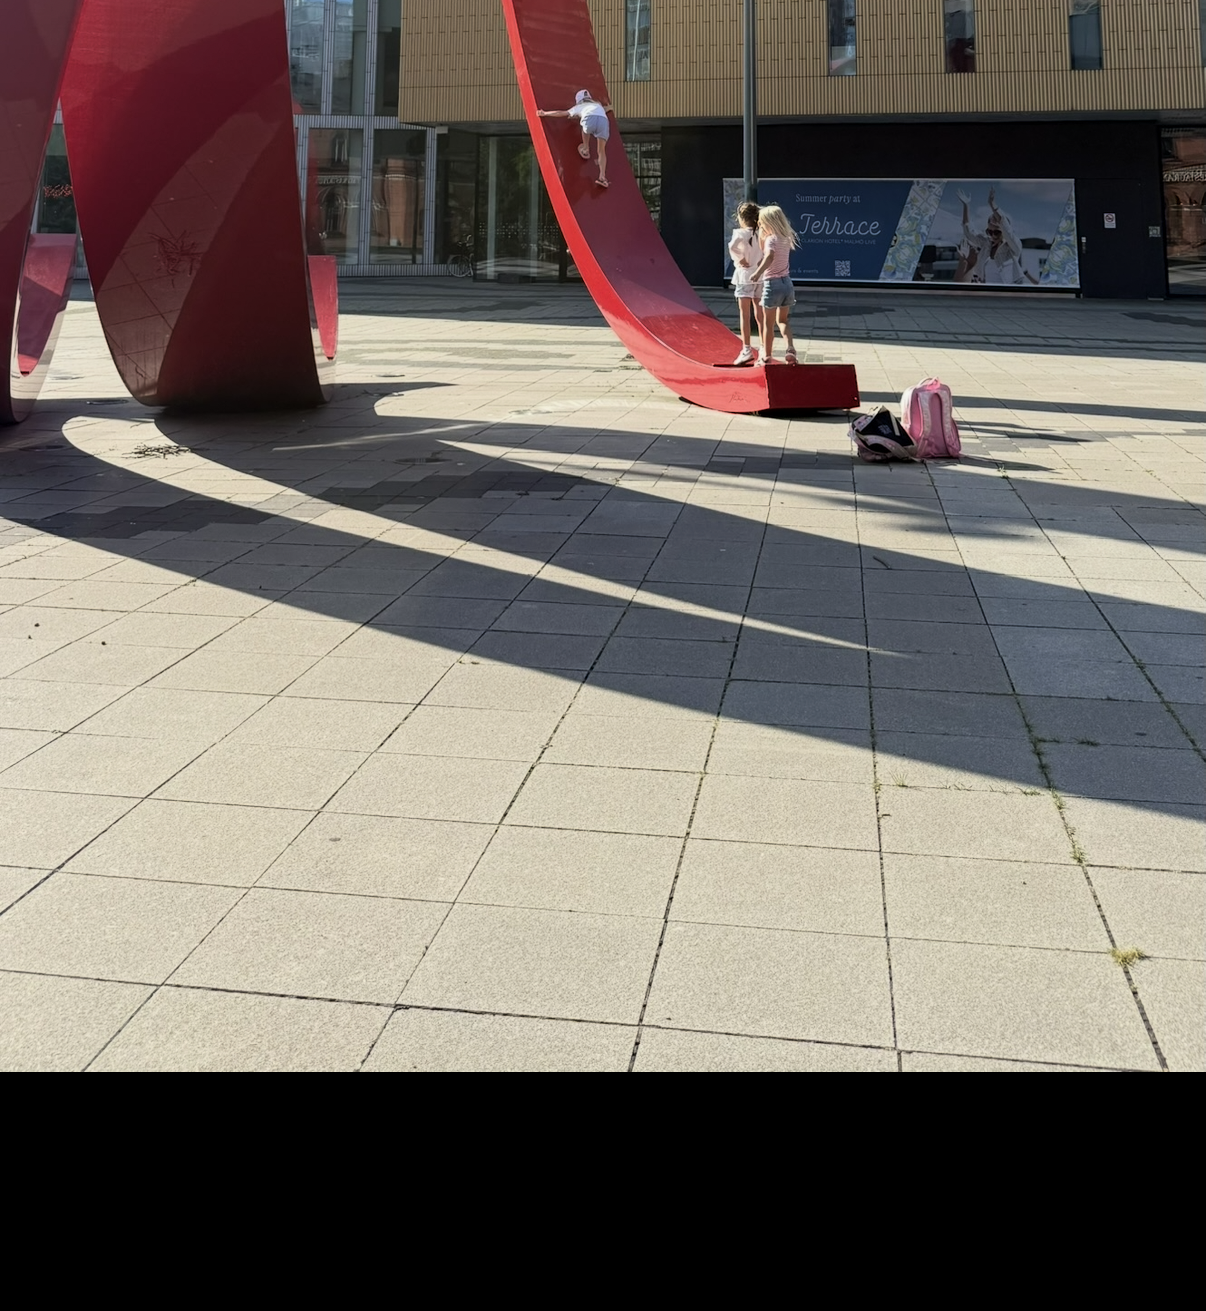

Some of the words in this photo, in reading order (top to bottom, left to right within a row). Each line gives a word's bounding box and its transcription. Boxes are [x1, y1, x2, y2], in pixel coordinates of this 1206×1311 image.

[796, 194, 827, 203] Summer
[828, 195, 851, 204] party
[853, 195, 861, 203] at
[799, 214, 882, 235] Terrace
